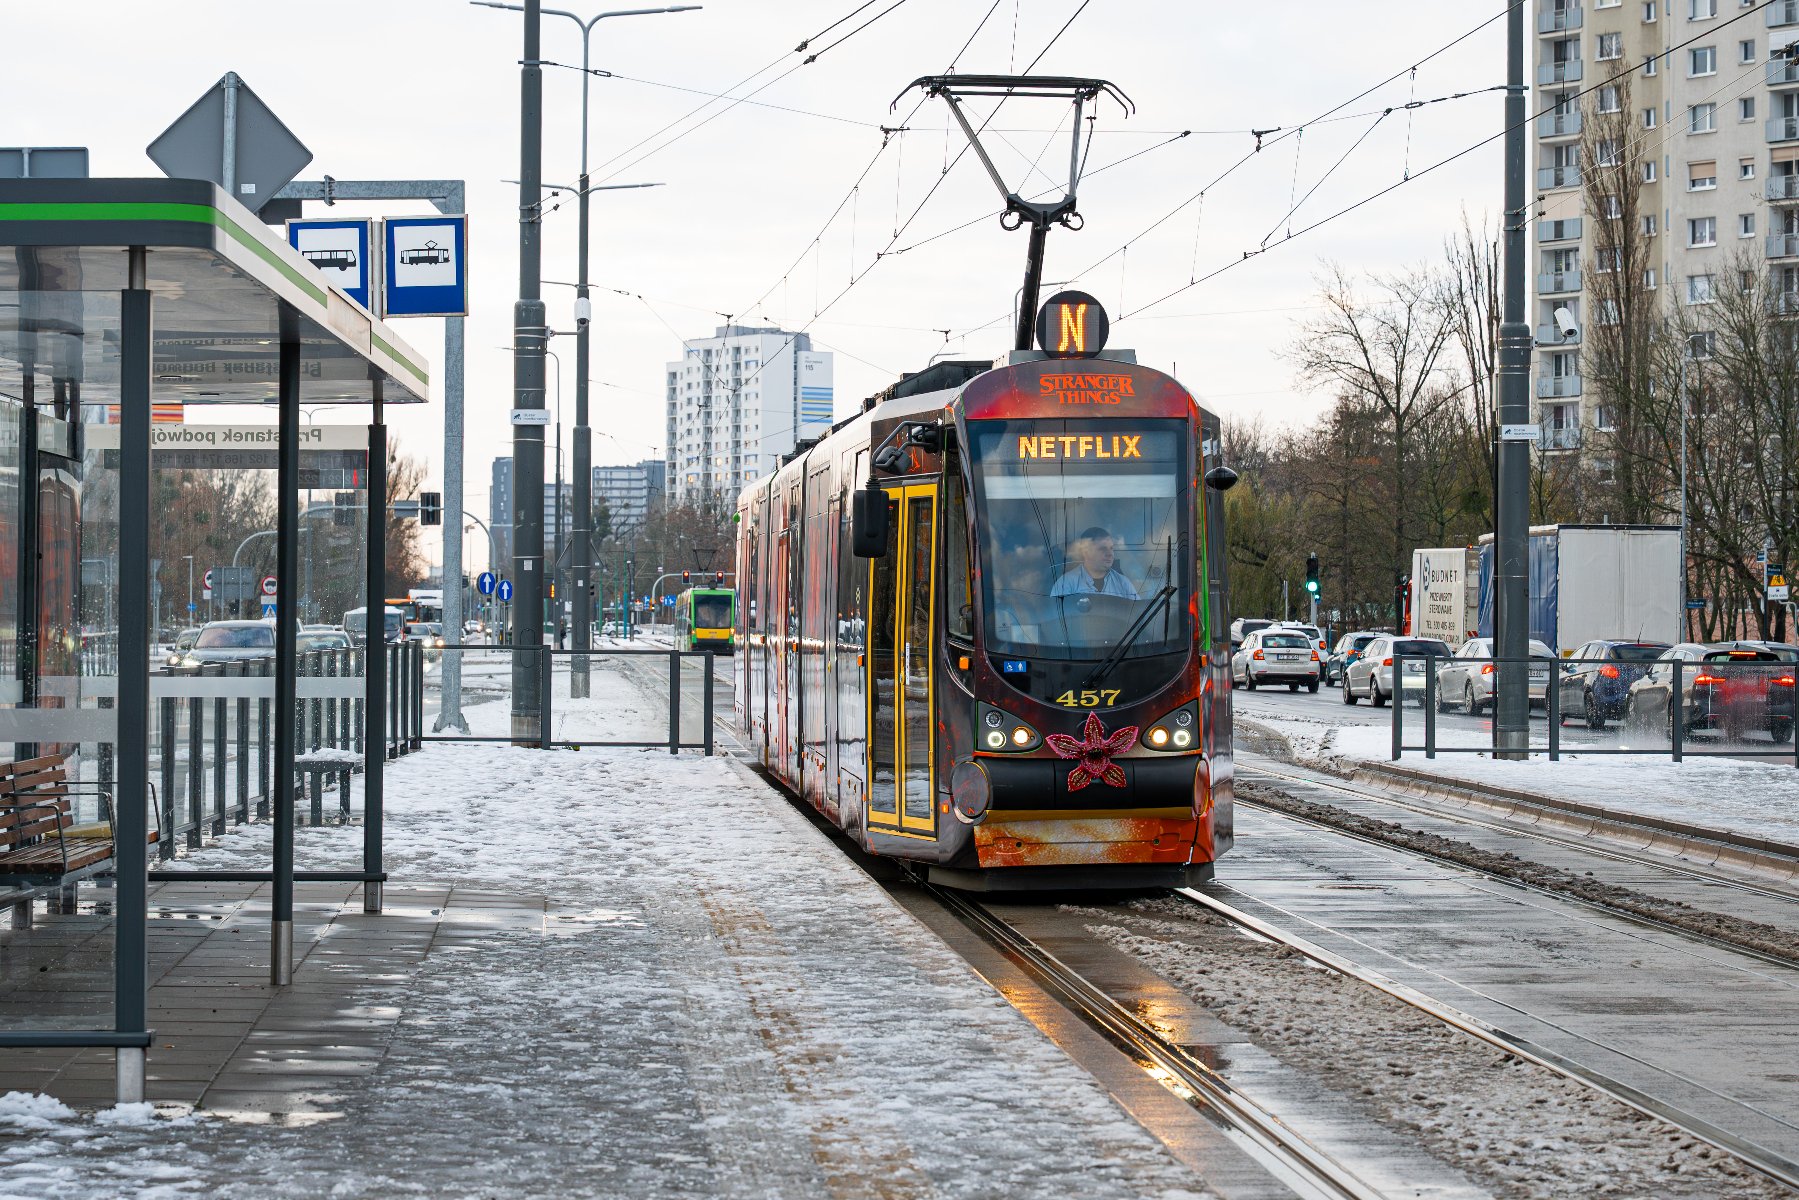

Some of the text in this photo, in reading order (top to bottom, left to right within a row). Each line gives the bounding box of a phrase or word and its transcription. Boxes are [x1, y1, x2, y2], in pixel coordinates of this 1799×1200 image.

[1058, 303, 1087, 352] N
[1039, 374, 1135, 396] STRANGER
[1056, 390, 1122, 405] THINGS
[1018, 435, 1142, 458] NETFLIX
[1431, 570, 1458, 582] BUDNET
[1056, 689, 1121, 707] 457
